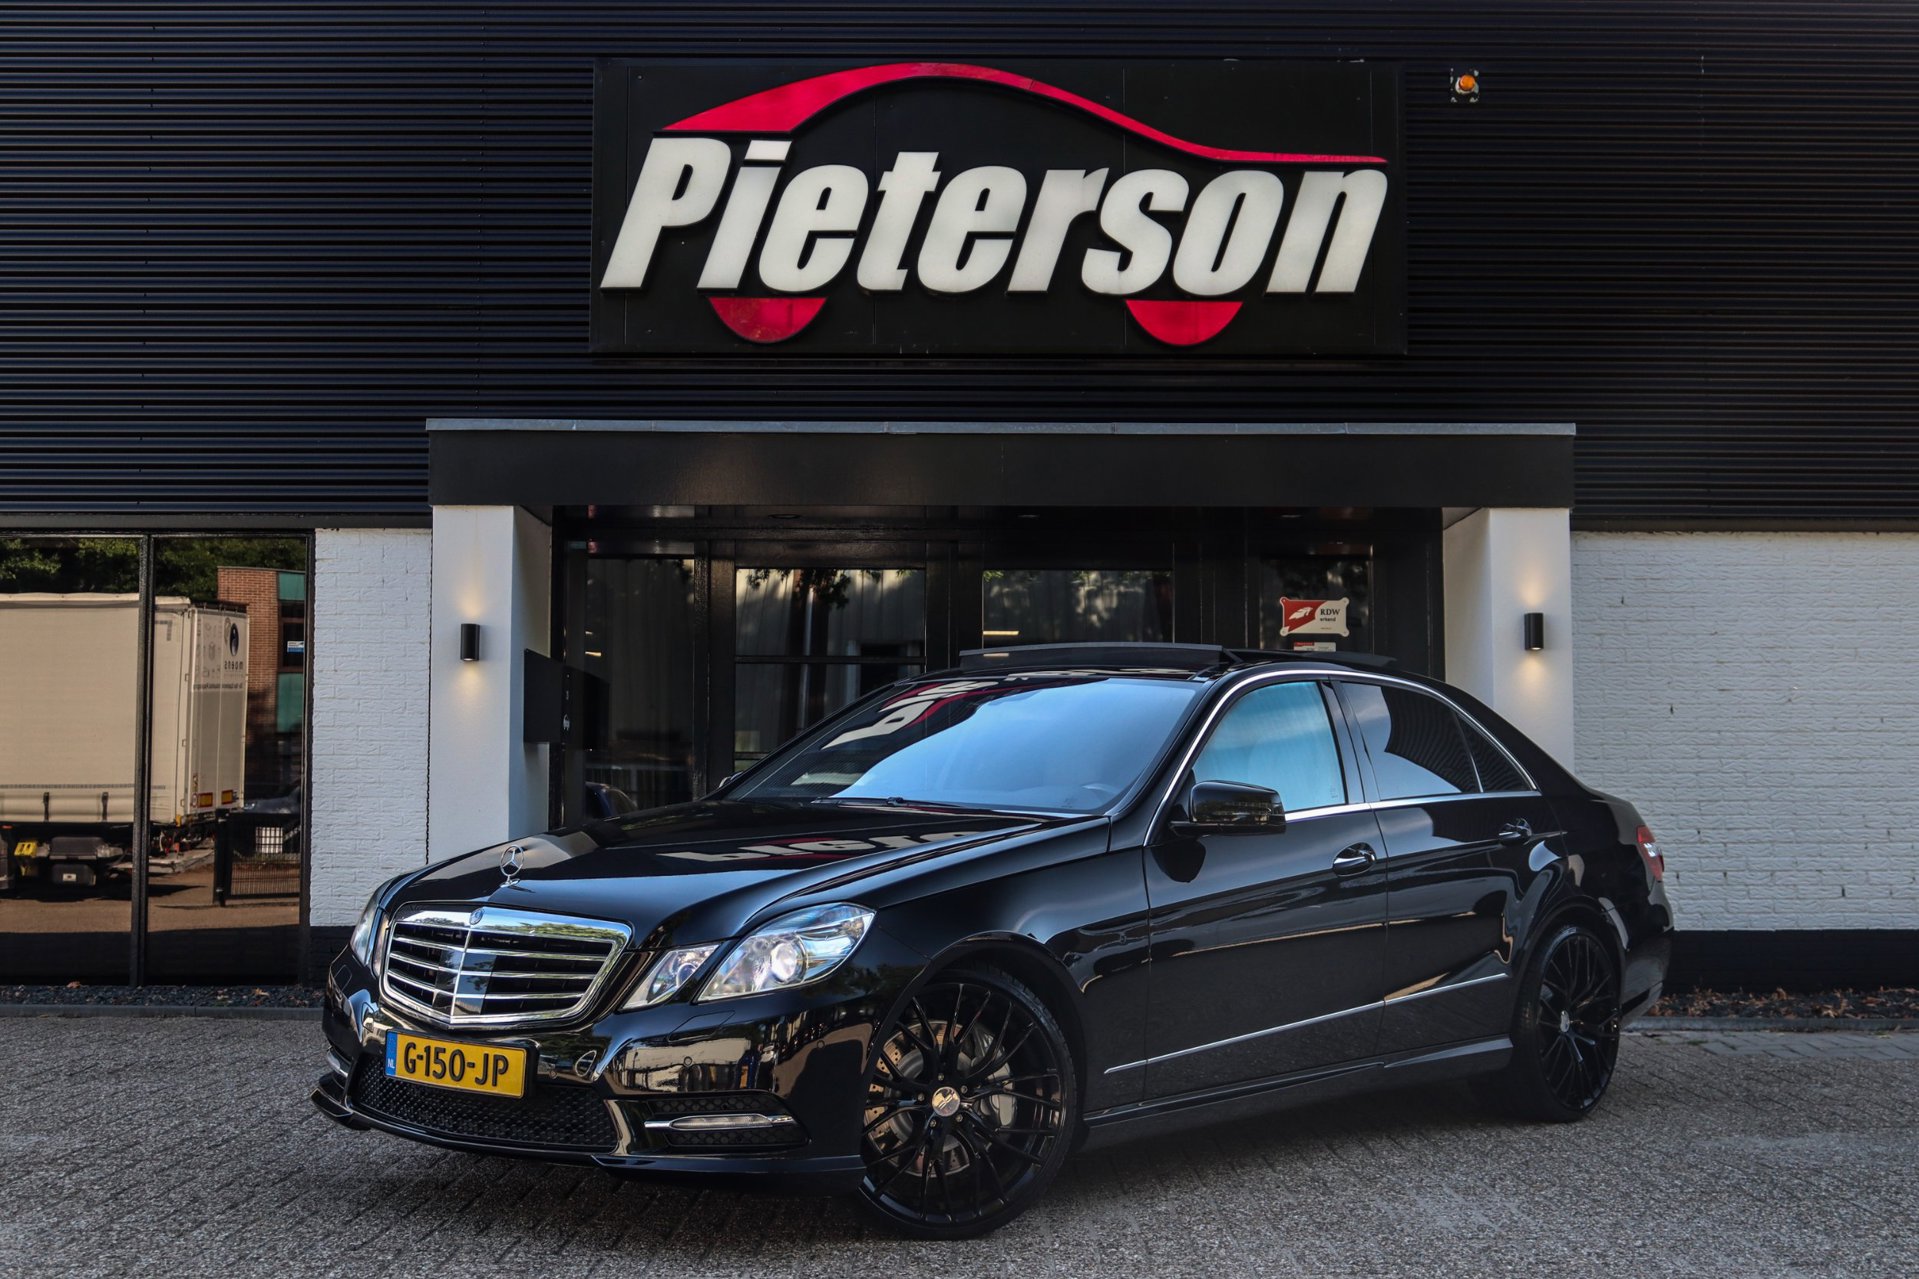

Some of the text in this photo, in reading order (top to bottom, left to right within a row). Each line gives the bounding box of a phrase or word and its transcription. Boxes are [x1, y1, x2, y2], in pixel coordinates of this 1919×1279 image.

[600, 136, 1388, 296] Pieterson
[1320, 608, 1341, 616] RDW
[387, 1058, 395, 1069] NL
[404, 1042, 509, 1087] G-150-JP
